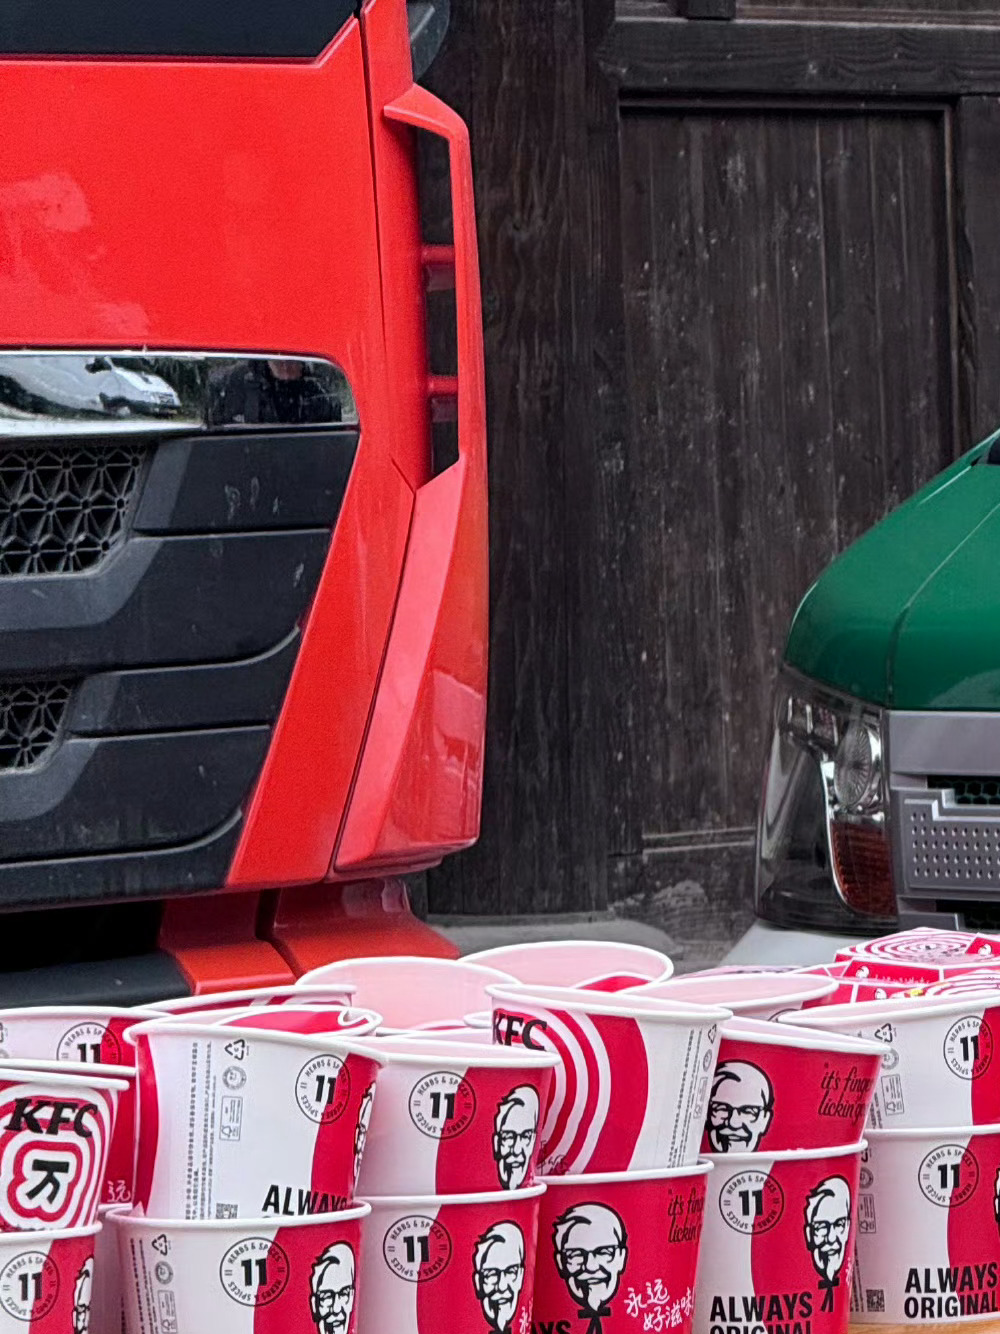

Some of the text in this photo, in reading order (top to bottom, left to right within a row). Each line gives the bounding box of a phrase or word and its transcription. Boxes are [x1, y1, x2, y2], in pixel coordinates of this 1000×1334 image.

[493, 1010, 547, 1051] KFC
[77, 1043, 101, 1062] 11
[960, 1035, 979, 1061] 11
[315, 1075, 336, 1104] 11
[4, 1097, 98, 1138] KFC
[430, 1092, 455, 1119] 11
[938, 1164, 960, 1189] 11
[739, 1190, 764, 1216] 11
[403, 1236, 429, 1263] 11
[241, 1259, 267, 1286] 11
[905, 1262, 998, 1293] ALWAYS
[18, 1272, 42, 1301] 11
[710, 1292, 813, 1322] ALWAYS
[904, 1291, 998, 1318] ORIGINAL
